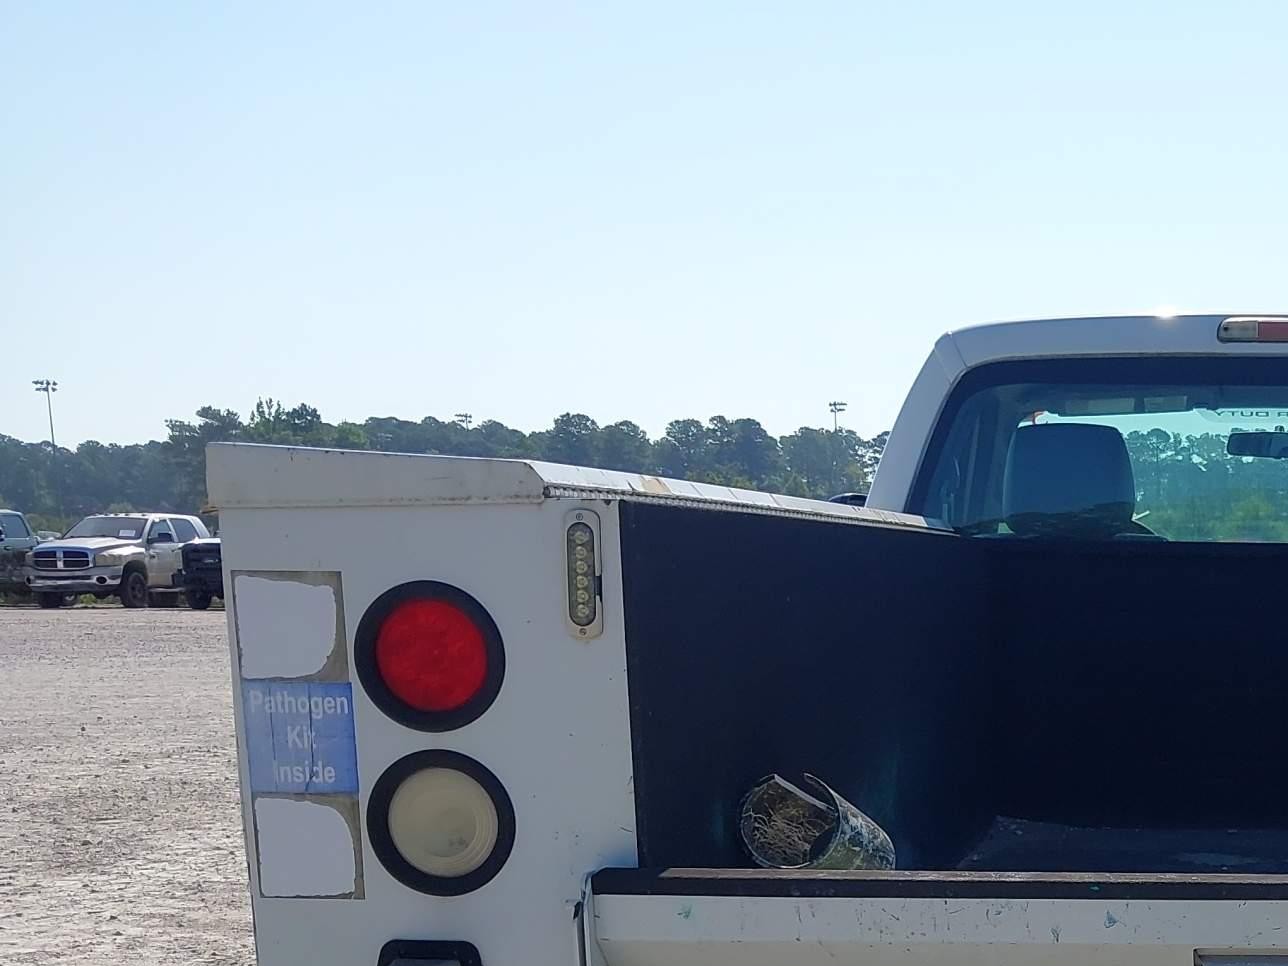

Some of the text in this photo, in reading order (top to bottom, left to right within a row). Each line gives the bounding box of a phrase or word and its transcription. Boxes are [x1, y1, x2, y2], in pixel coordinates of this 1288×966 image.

[249, 690, 349, 719] Pathogen
[287, 726, 317, 750] Kit
[273, 760, 336, 784] Inside
